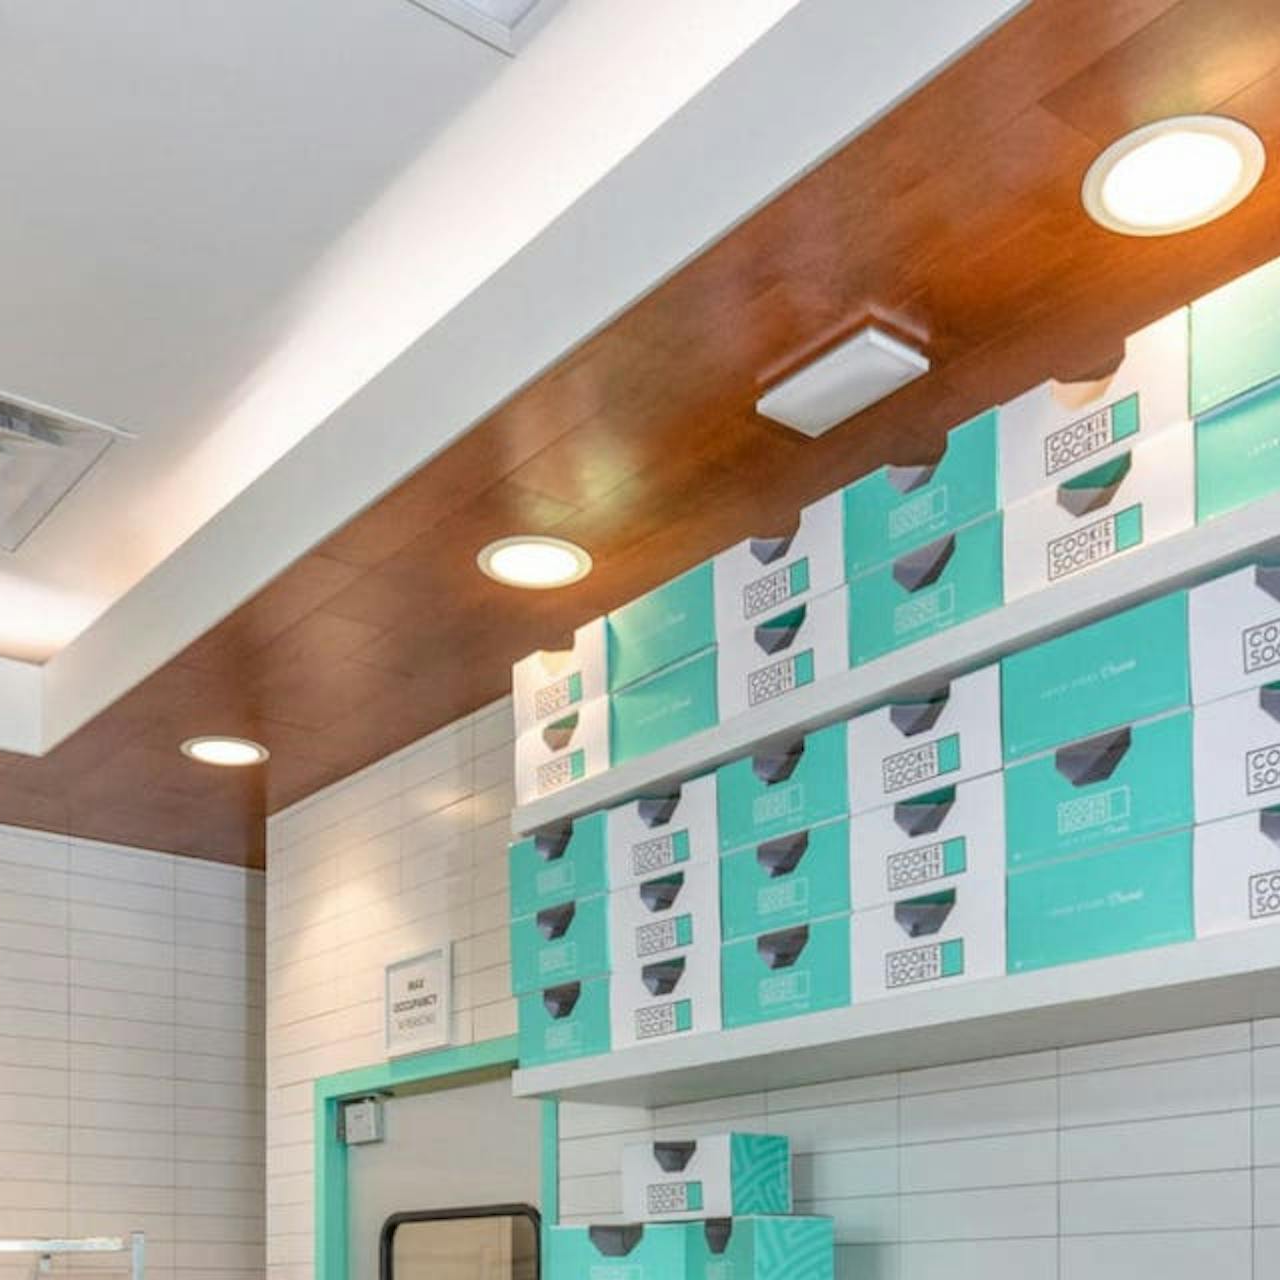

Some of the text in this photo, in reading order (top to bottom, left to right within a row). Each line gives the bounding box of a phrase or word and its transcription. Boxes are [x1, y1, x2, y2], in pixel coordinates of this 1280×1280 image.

[1050, 412, 1108, 452] COOKIE
[1051, 432, 1108, 469] SOCIETY
[1052, 521, 1111, 558] COOKIE
[1053, 540, 1111, 574] SOCIETY
[887, 747, 935, 773] COOKIE
[887, 761, 936, 787] SOCIETY
[891, 847, 940, 871] COOKIE
[892, 863, 940, 886] SOCIETY
[891, 947, 938, 969] COOKIE
[891, 962, 939, 985] SOCIETY
